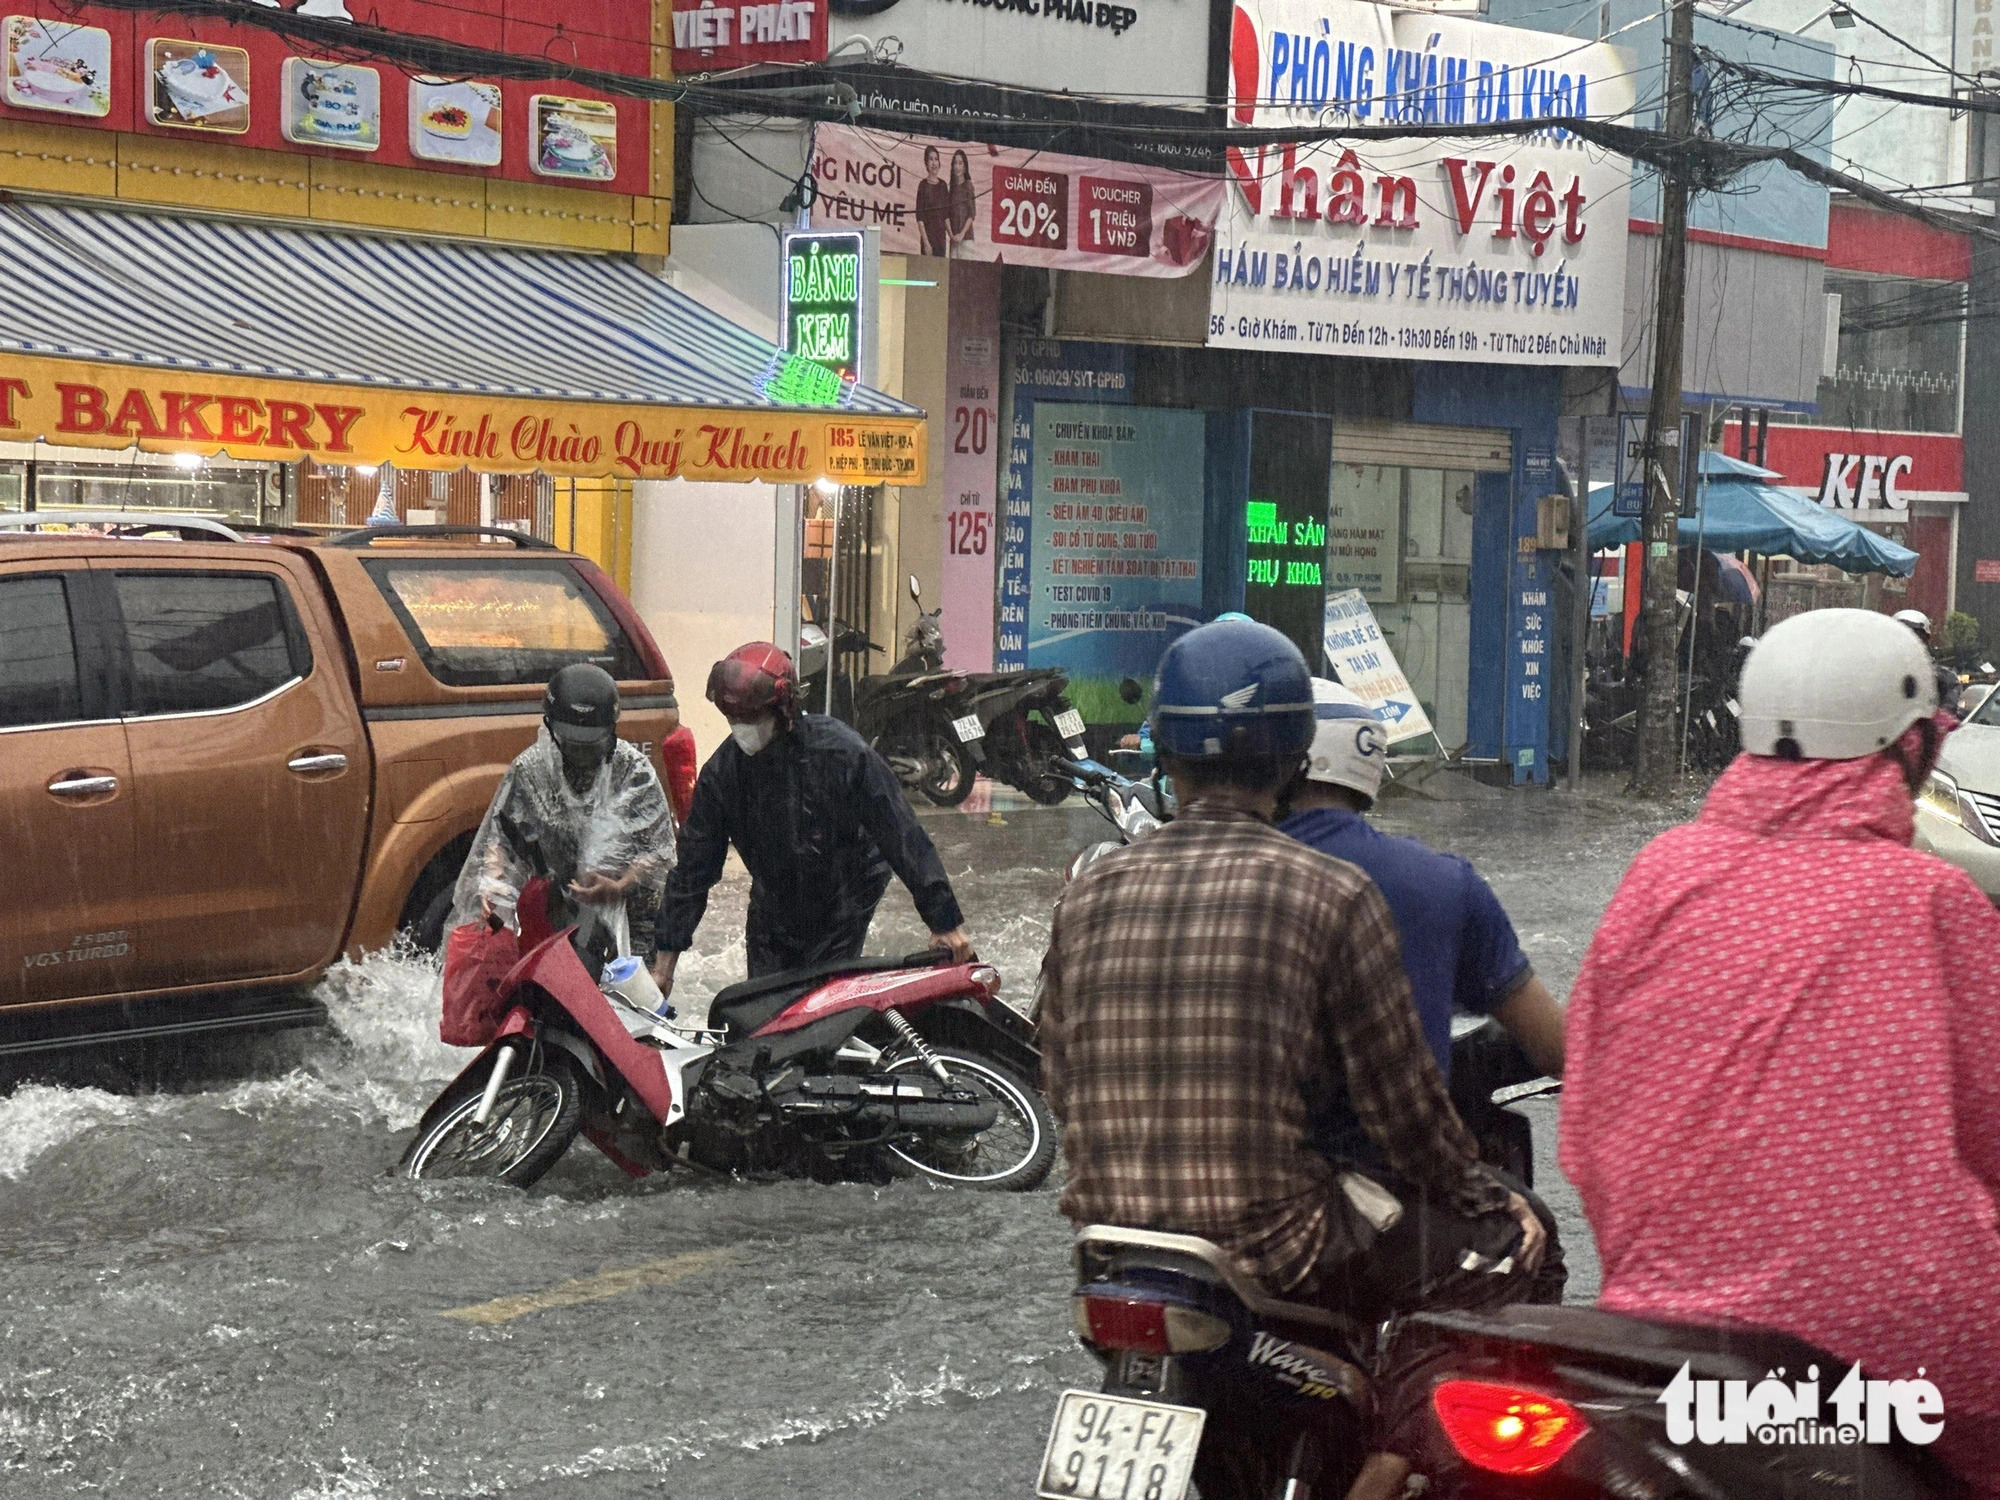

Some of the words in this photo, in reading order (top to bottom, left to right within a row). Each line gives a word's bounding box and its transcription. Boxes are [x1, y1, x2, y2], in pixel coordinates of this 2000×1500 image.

[672, 1, 735, 57] VIỆT
[740, 0, 816, 45] PHÁT
[1270, 17, 1374, 117] PHÒNG
[1384, 33, 1467, 124] KHÁM
[1477, 60, 1510, 124] ĐA
[1522, 66, 1587, 141] KHOA
[846, 160, 901, 189] NGỜI
[1005, 174, 1033, 193] GIẢM
[1036, 177, 1057, 195] ĐẾN
[1091, 186, 1141, 205] VOUCHER
[1226, 142, 1420, 229] Nhân
[1443, 157, 1586, 258] Việt
[821, 191, 865, 222] YÊU
[873, 201, 906, 233] MẸ
[999, 198, 1060, 241] 20%
[1089, 208, 1101, 246] 1
[1105, 210, 1137, 231] TRIỆU
[1106, 230, 1137, 247] VNĐ
[1273, 240, 1321, 290] BẢO
[1326, 240, 1381, 297] HIỂM
[1387, 262, 1400, 296] Y
[1404, 249, 1433, 299] TẾ
[1436, 260, 1508, 304] THÔNG
[1513, 259, 1579, 308] TUYẾN
[797, 313, 849, 360] KEM
[1238, 316, 1261, 338] Giờ
[1263, 319, 1297, 341] Khám
[1308, 321, 1324, 342] Từ
[1326, 325, 1339, 343] 7h
[1343, 320, 1365, 345] Đến
[1368, 326, 1388, 346] 12h
[1399, 327, 1431, 349] 13h30
[1434, 327, 1455, 349] Đến
[1459, 331, 1478, 350] 19h
[1490, 333, 1504, 351] Từ
[1506, 333, 1526, 353] Thứ
[1528, 335, 1534, 353] 2
[1537, 332, 1556, 354] Đến
[1559, 333, 1580, 355] Chủ
[1582, 336, 1606, 358] Nhật
[55, 381, 365, 453] BAKERY
[394, 406, 502, 459] Kính
[511, 415, 604, 464] Chào
[614, 419, 686, 476] Quý
[692, 425, 812, 471] Khách
[830, 427, 855, 448] 185
[1056, 421, 1089, 440] CHUYÊN
[1092, 425, 1113, 441] KHOA
[1082, 452, 1099, 467] THAI
[1080, 478, 1096, 498] PHỤ
[1100, 479, 1121, 494] KHOA
[1819, 453, 1913, 511] KFC
[1053, 501, 1073, 520] SIÊU
[1092, 506, 1102, 520] 4D
[1053, 532, 1067, 548] SOI
[1123, 533, 1137, 548] SOI
[1294, 515, 1325, 546] SẢN
[1053, 556, 1069, 574] XÉT
[1072, 557, 1103, 578] NGHIỆM
[1178, 562, 1196, 577] THAI
[1247, 559, 1280, 587] PHỤ
[1286, 561, 1322, 585] KHOA
[1053, 586, 1073, 602] TEST
[1076, 587, 1100, 602] COVID
[1102, 587, 1111, 602] 19
[1522, 588, 1547, 606] KHÁM
[1051, 609, 1079, 629] PHÒNG
[1081, 609, 1102, 629] TIÊM
[1525, 612, 1542, 631] SỨC
[1326, 629, 1355, 652] KHÔNG
[1366, 624, 1380, 643] XE
[1522, 634, 1545, 654] KHỎE
[1347, 656, 1365, 676] TẠI
[1363, 649, 1381, 671] ĐÂY
[1525, 661, 1539, 676] XIN
[1522, 683, 1541, 701] VIỆC
[66, 943, 129, 962] TURBO
[1247, 1331, 1335, 1386] Wave
[1074, 1403, 1175, 1457] 94-F4
[1061, 1450, 1168, 1500] 9118
